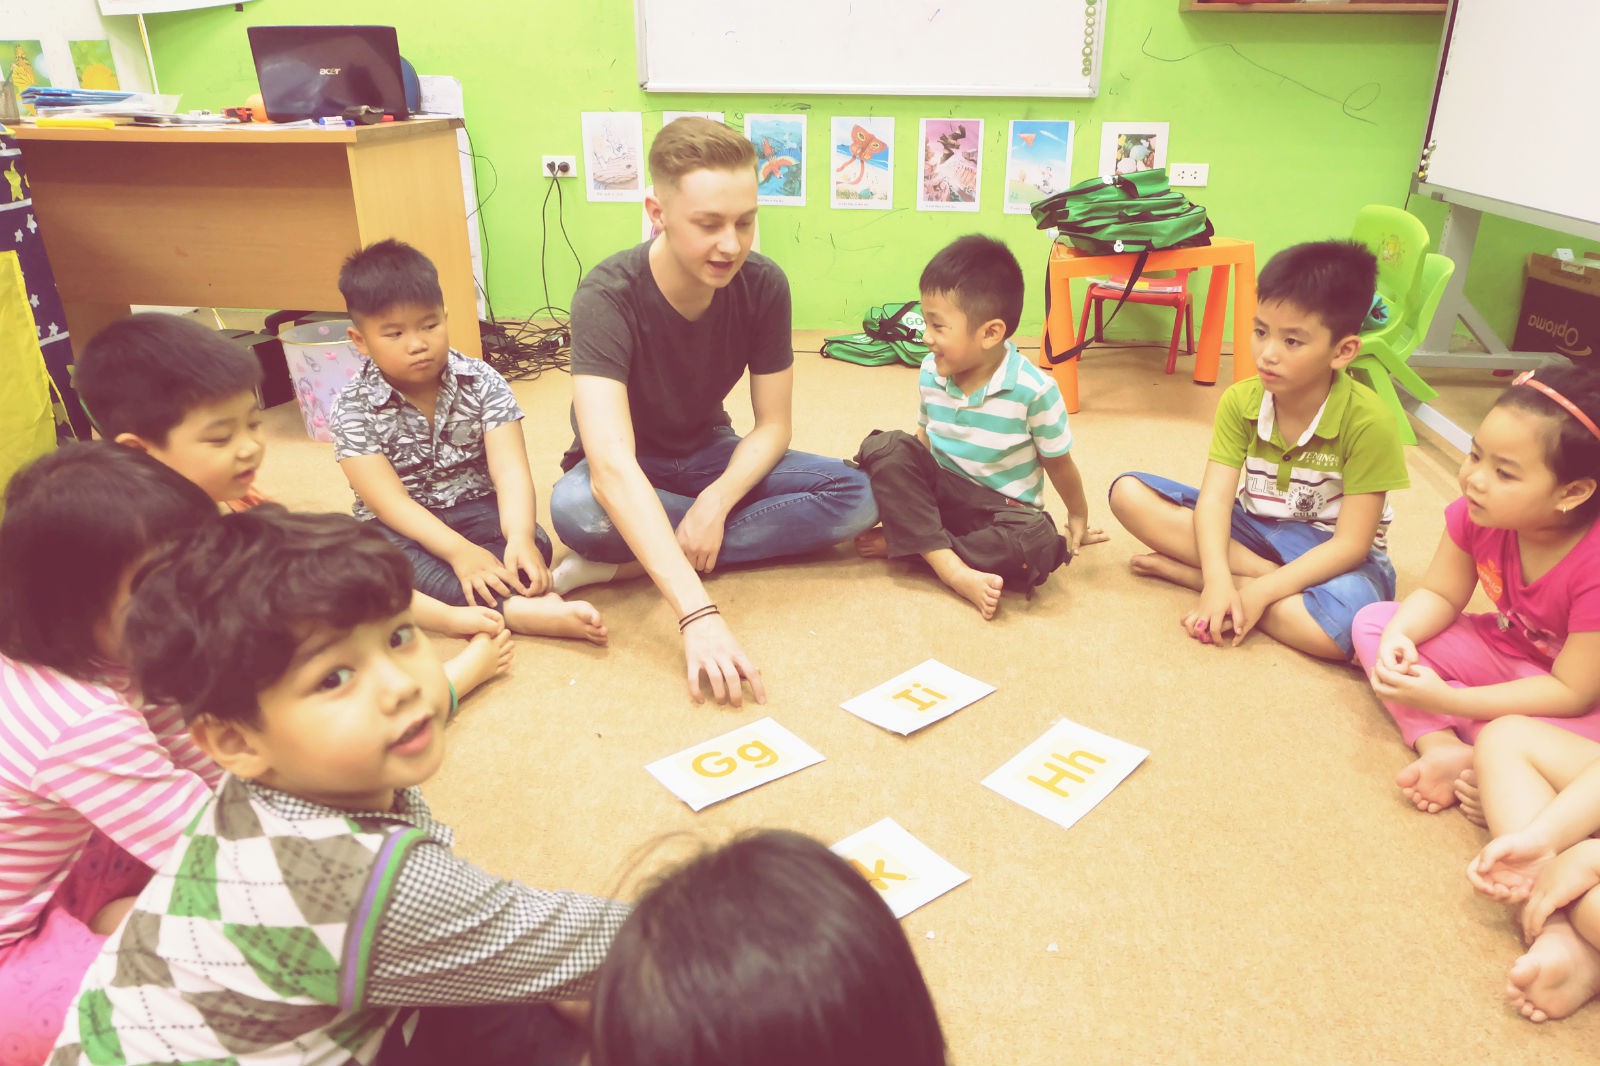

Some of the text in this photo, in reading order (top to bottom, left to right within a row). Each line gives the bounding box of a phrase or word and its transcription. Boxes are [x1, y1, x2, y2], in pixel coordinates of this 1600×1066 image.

[1527, 314, 1579, 347] Optoma
[892, 683, 947, 711] Ii
[691, 740, 779, 778] Gg
[1026, 750, 1107, 798] Hh
[848, 858, 907, 890] k
